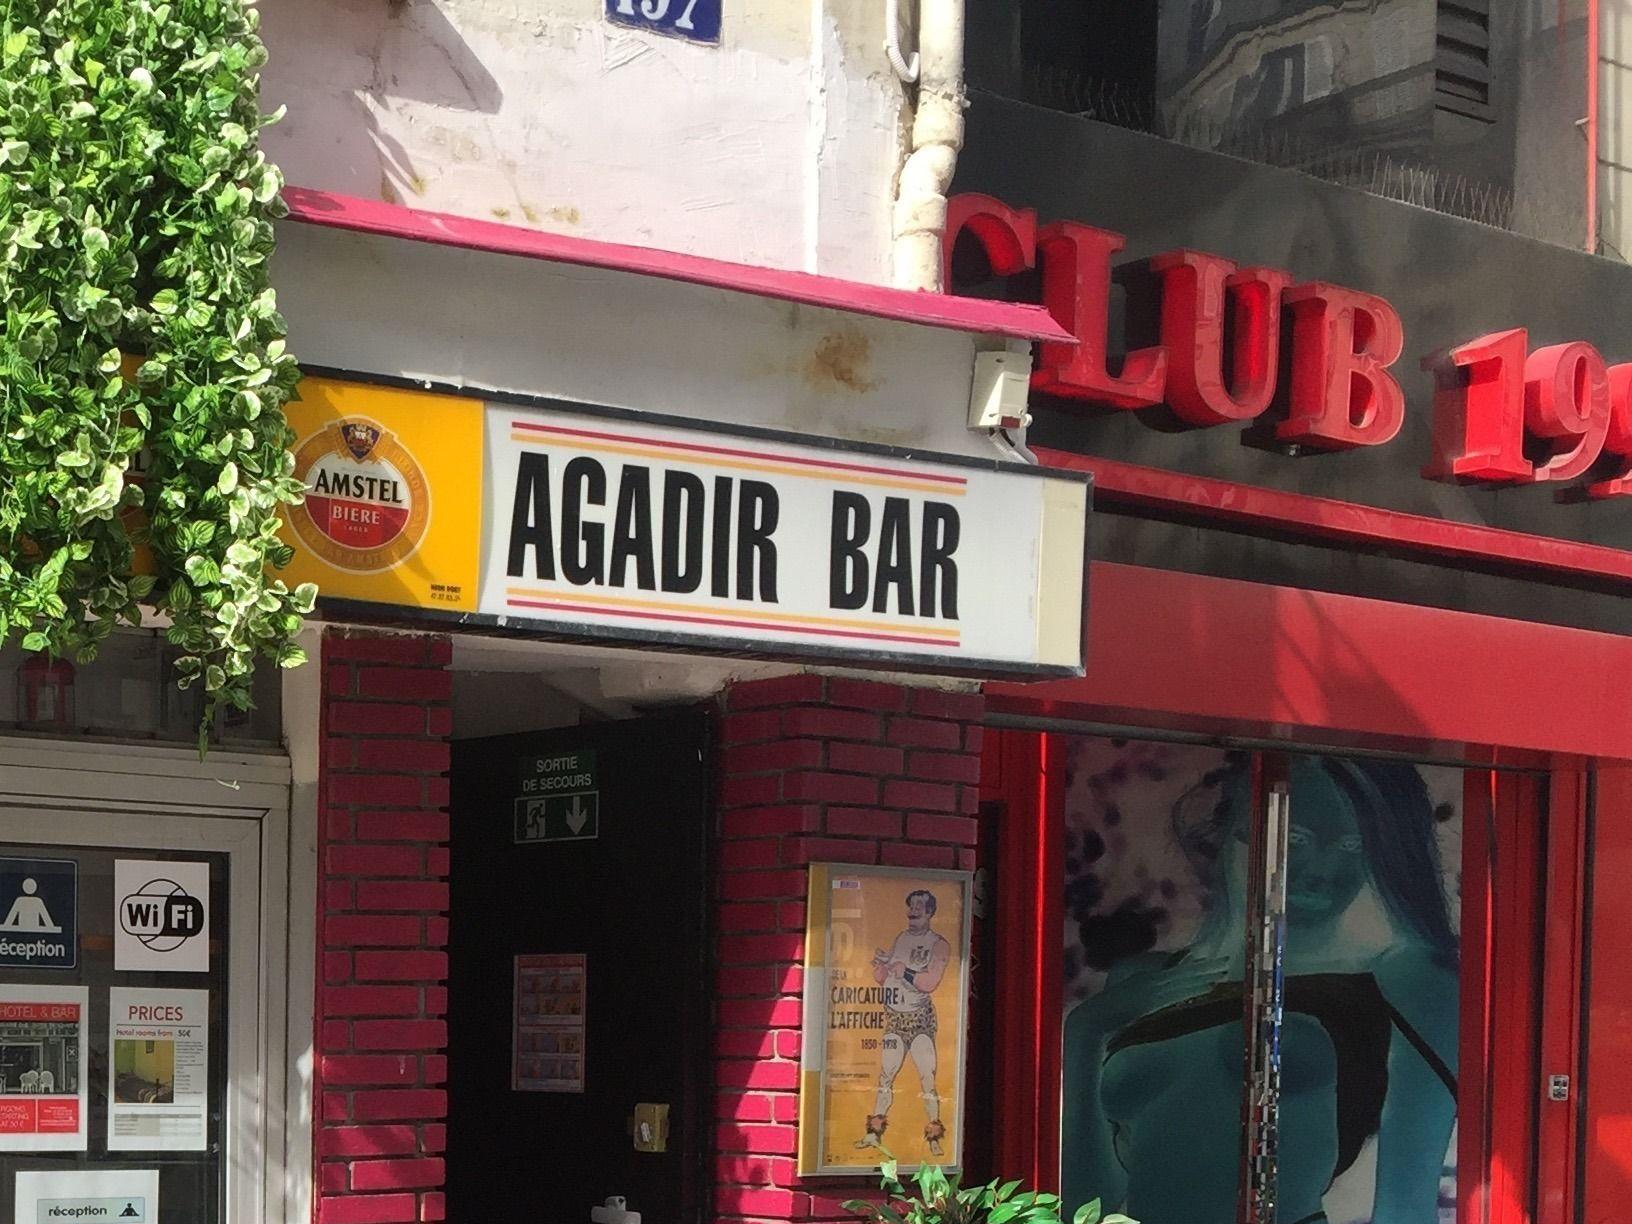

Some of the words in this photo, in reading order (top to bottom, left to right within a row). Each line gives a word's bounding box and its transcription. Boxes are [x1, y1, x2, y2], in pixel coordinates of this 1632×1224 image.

[945, 191, 1406, 448] CLUB
[313, 470, 404, 514] AMSTEL
[331, 505, 381, 526] BIERE
[506, 450, 779, 604] AGADIR
[829, 490, 961, 621] BAR
[536, 755, 578, 773] SORTIE
[522, 779, 538, 792] DE
[539, 773, 592, 790] SECOURS
[831, 986, 899, 1005] CARICATURE
[41, 1007, 48, 1018] &
[51, 1008, 77, 1018] BAR
[128, 1005, 184, 1021] PRICES
[831, 1011, 885, 1029] L'AFFICHE
[48, 1206, 107, 1218] réception
